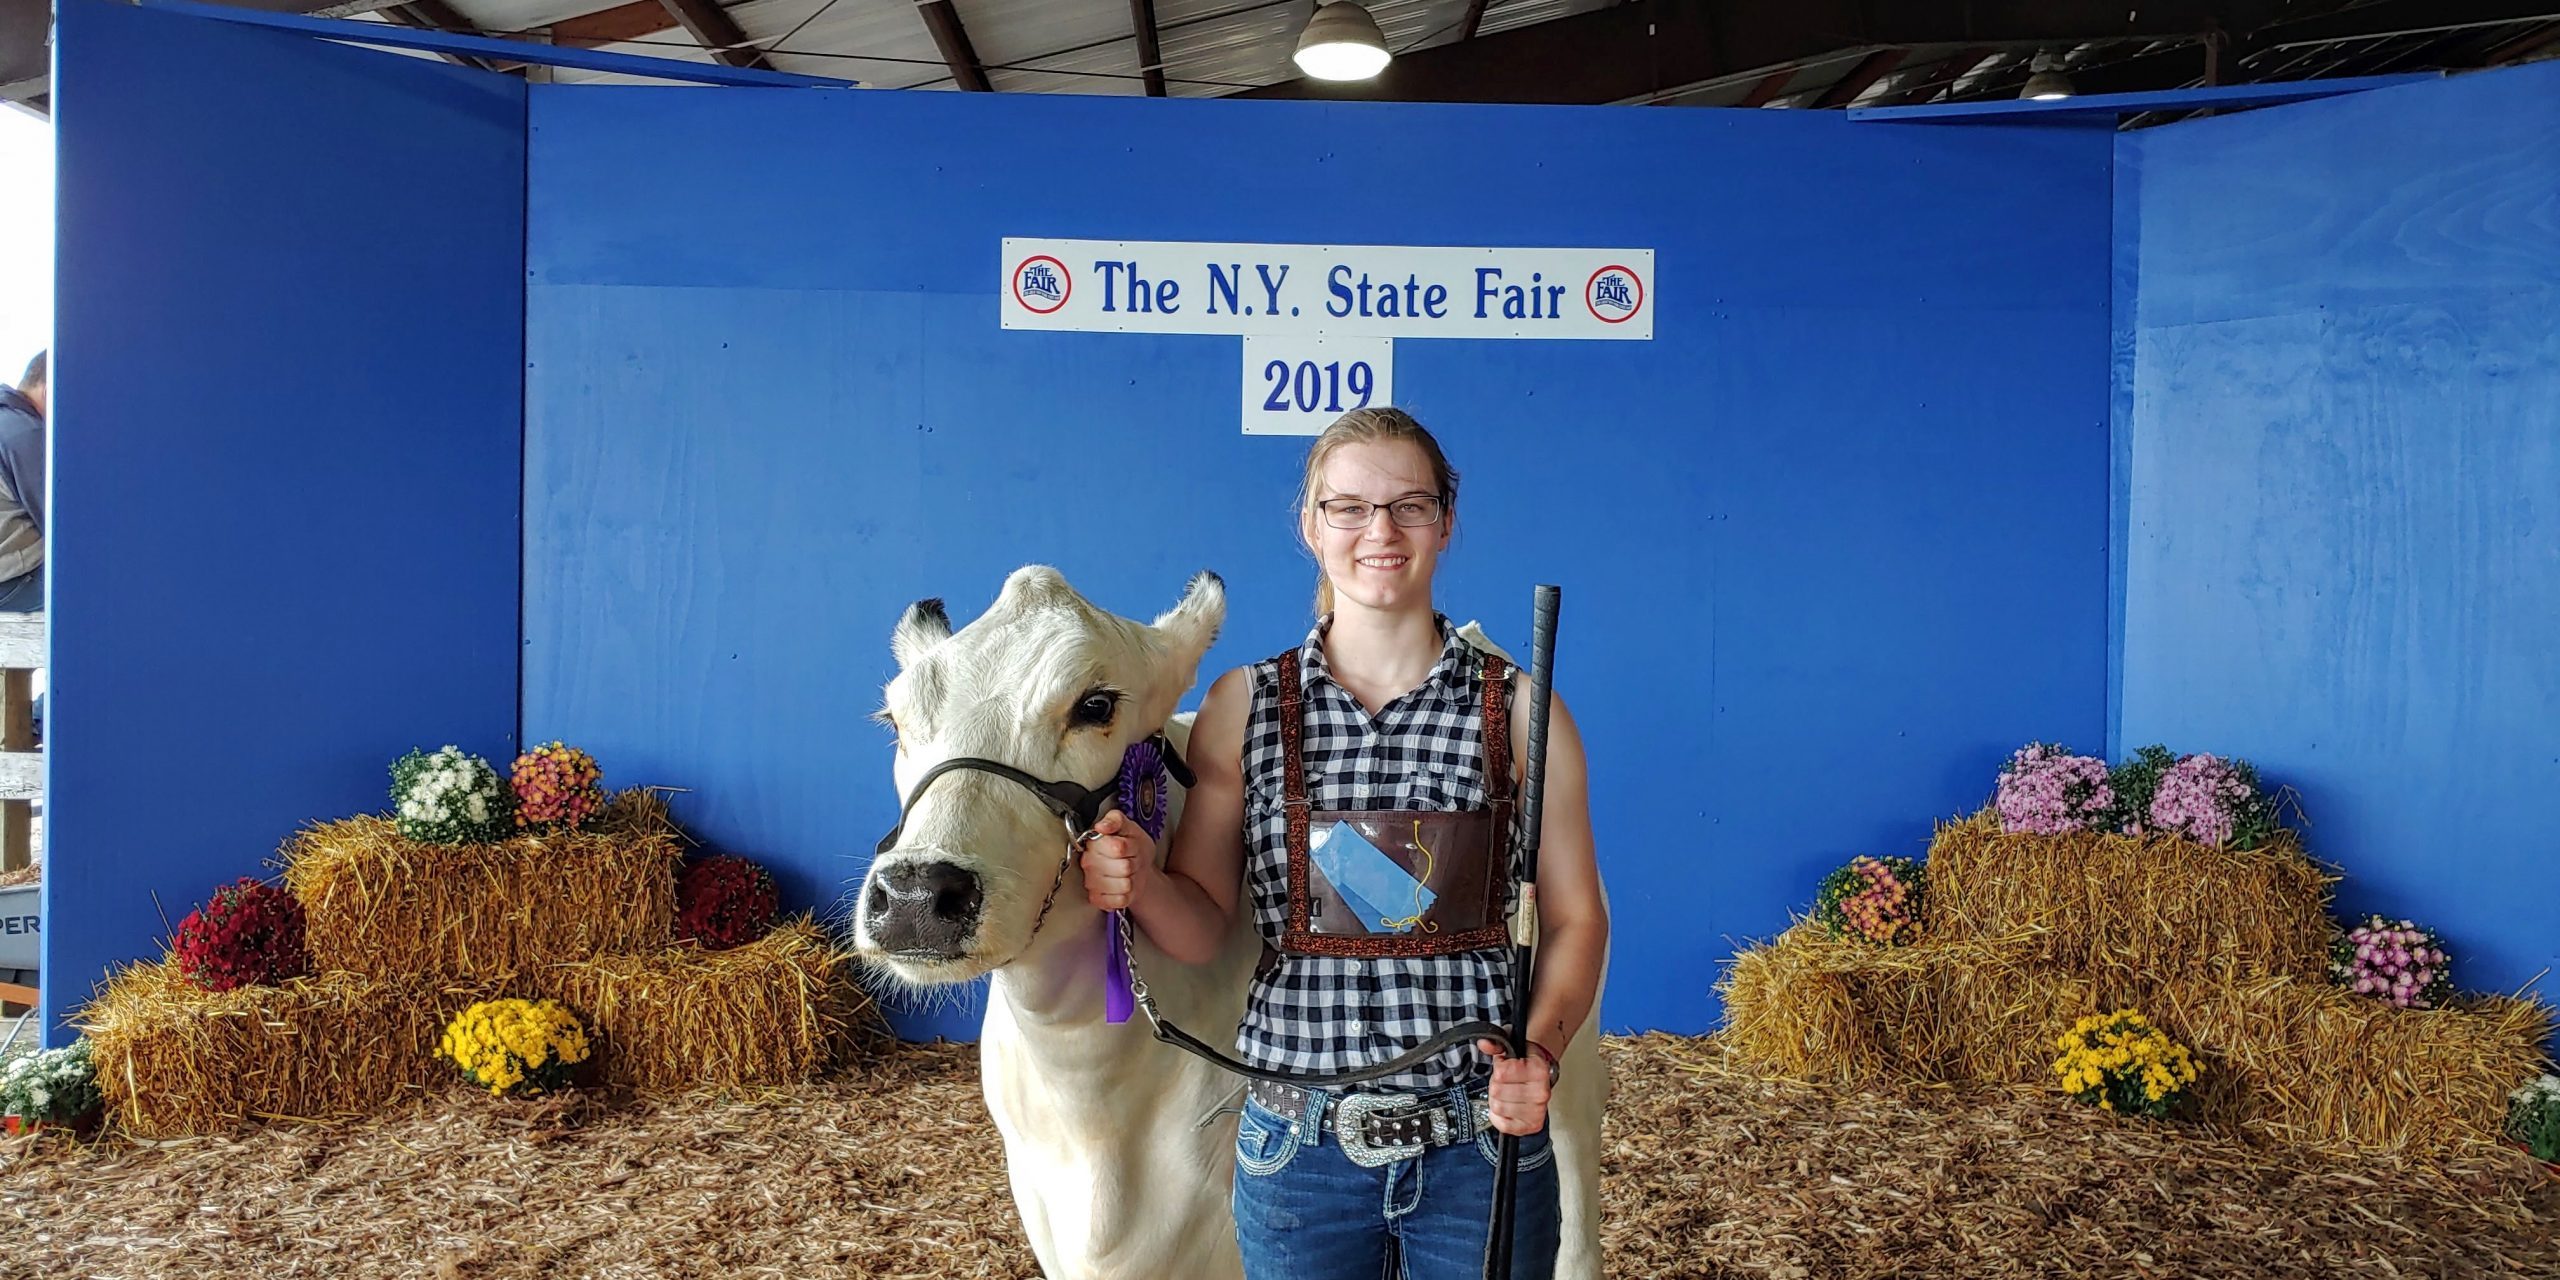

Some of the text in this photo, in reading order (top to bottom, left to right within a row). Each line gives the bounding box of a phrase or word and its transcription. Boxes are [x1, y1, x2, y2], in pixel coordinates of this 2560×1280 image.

[1030, 264, 1053, 276] THE
[1602, 274, 1625, 286] THE
[1023, 271, 1060, 294] FAIR
[1094, 261, 1566, 319] The N.Y. State Fair
[1596, 281, 1632, 304] FAIR
[1263, 360, 1373, 413] 2019
[0, 915, 40, 935] ER
